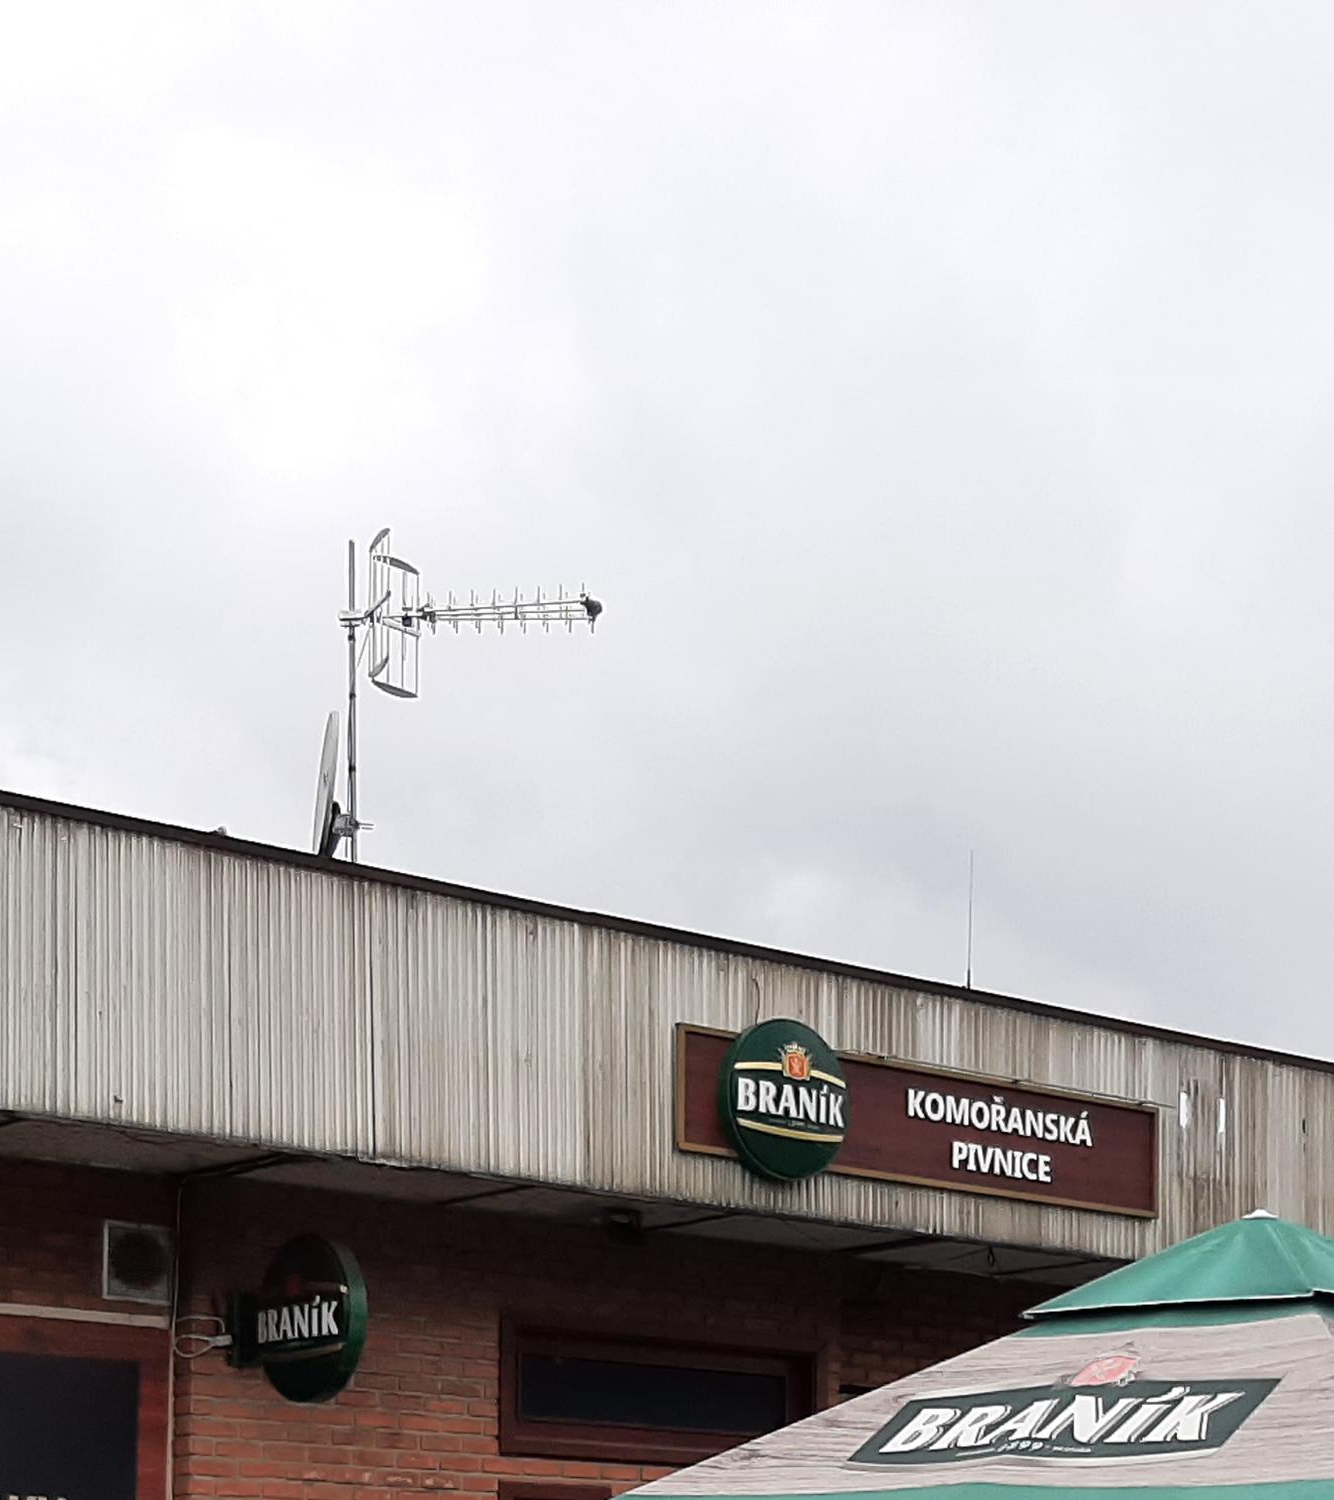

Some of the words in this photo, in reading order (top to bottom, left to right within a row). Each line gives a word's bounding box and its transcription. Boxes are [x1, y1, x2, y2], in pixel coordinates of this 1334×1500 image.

[736, 1076, 845, 1128] BRANÍK
[907, 1087, 1093, 1147] KOMOŘANSKÁ
[952, 1140, 1052, 1184] PIVNICE
[258, 1294, 339, 1344] BRANÍK
[879, 1388, 1246, 1454] BRANÍK
